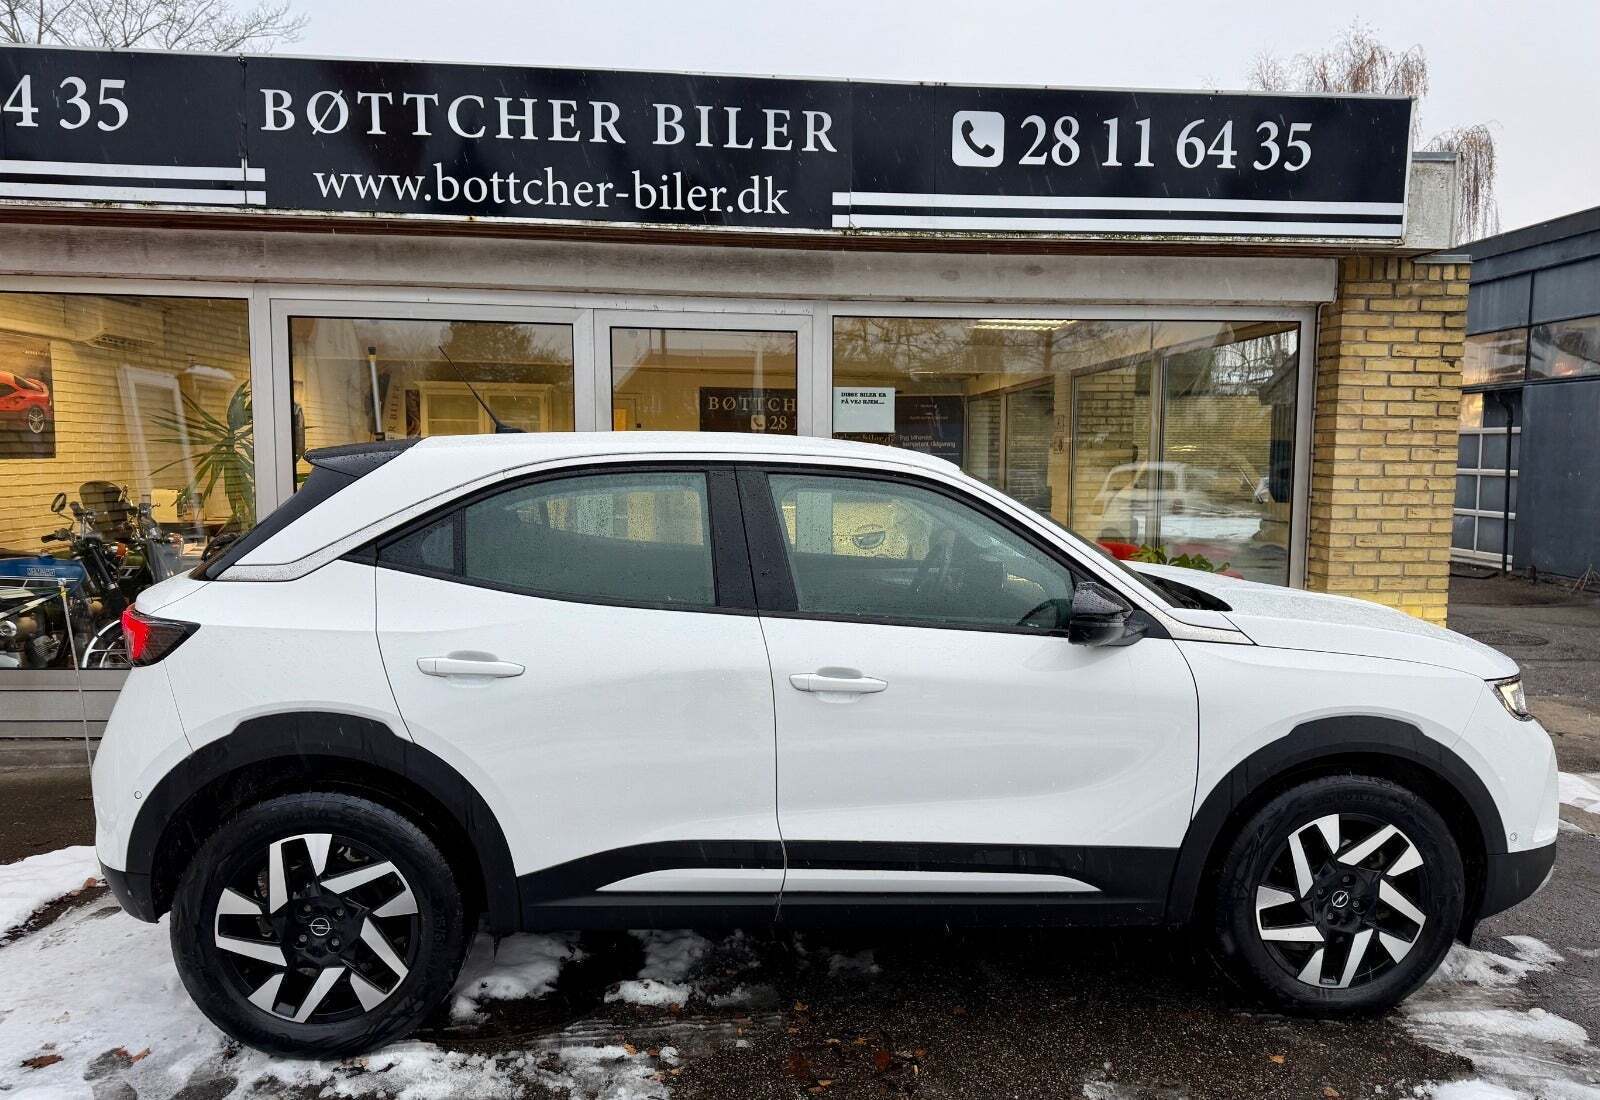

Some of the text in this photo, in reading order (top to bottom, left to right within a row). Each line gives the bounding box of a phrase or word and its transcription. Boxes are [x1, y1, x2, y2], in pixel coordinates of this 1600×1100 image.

[0, 74, 129, 132] 4 35
[259, 88, 838, 153] BØTTCHER BILER
[1018, 114, 1313, 172] 28 11 64 35
[312, 162, 790, 215] www.bottcher-biler.dk
[769, 415, 788, 430] 28
